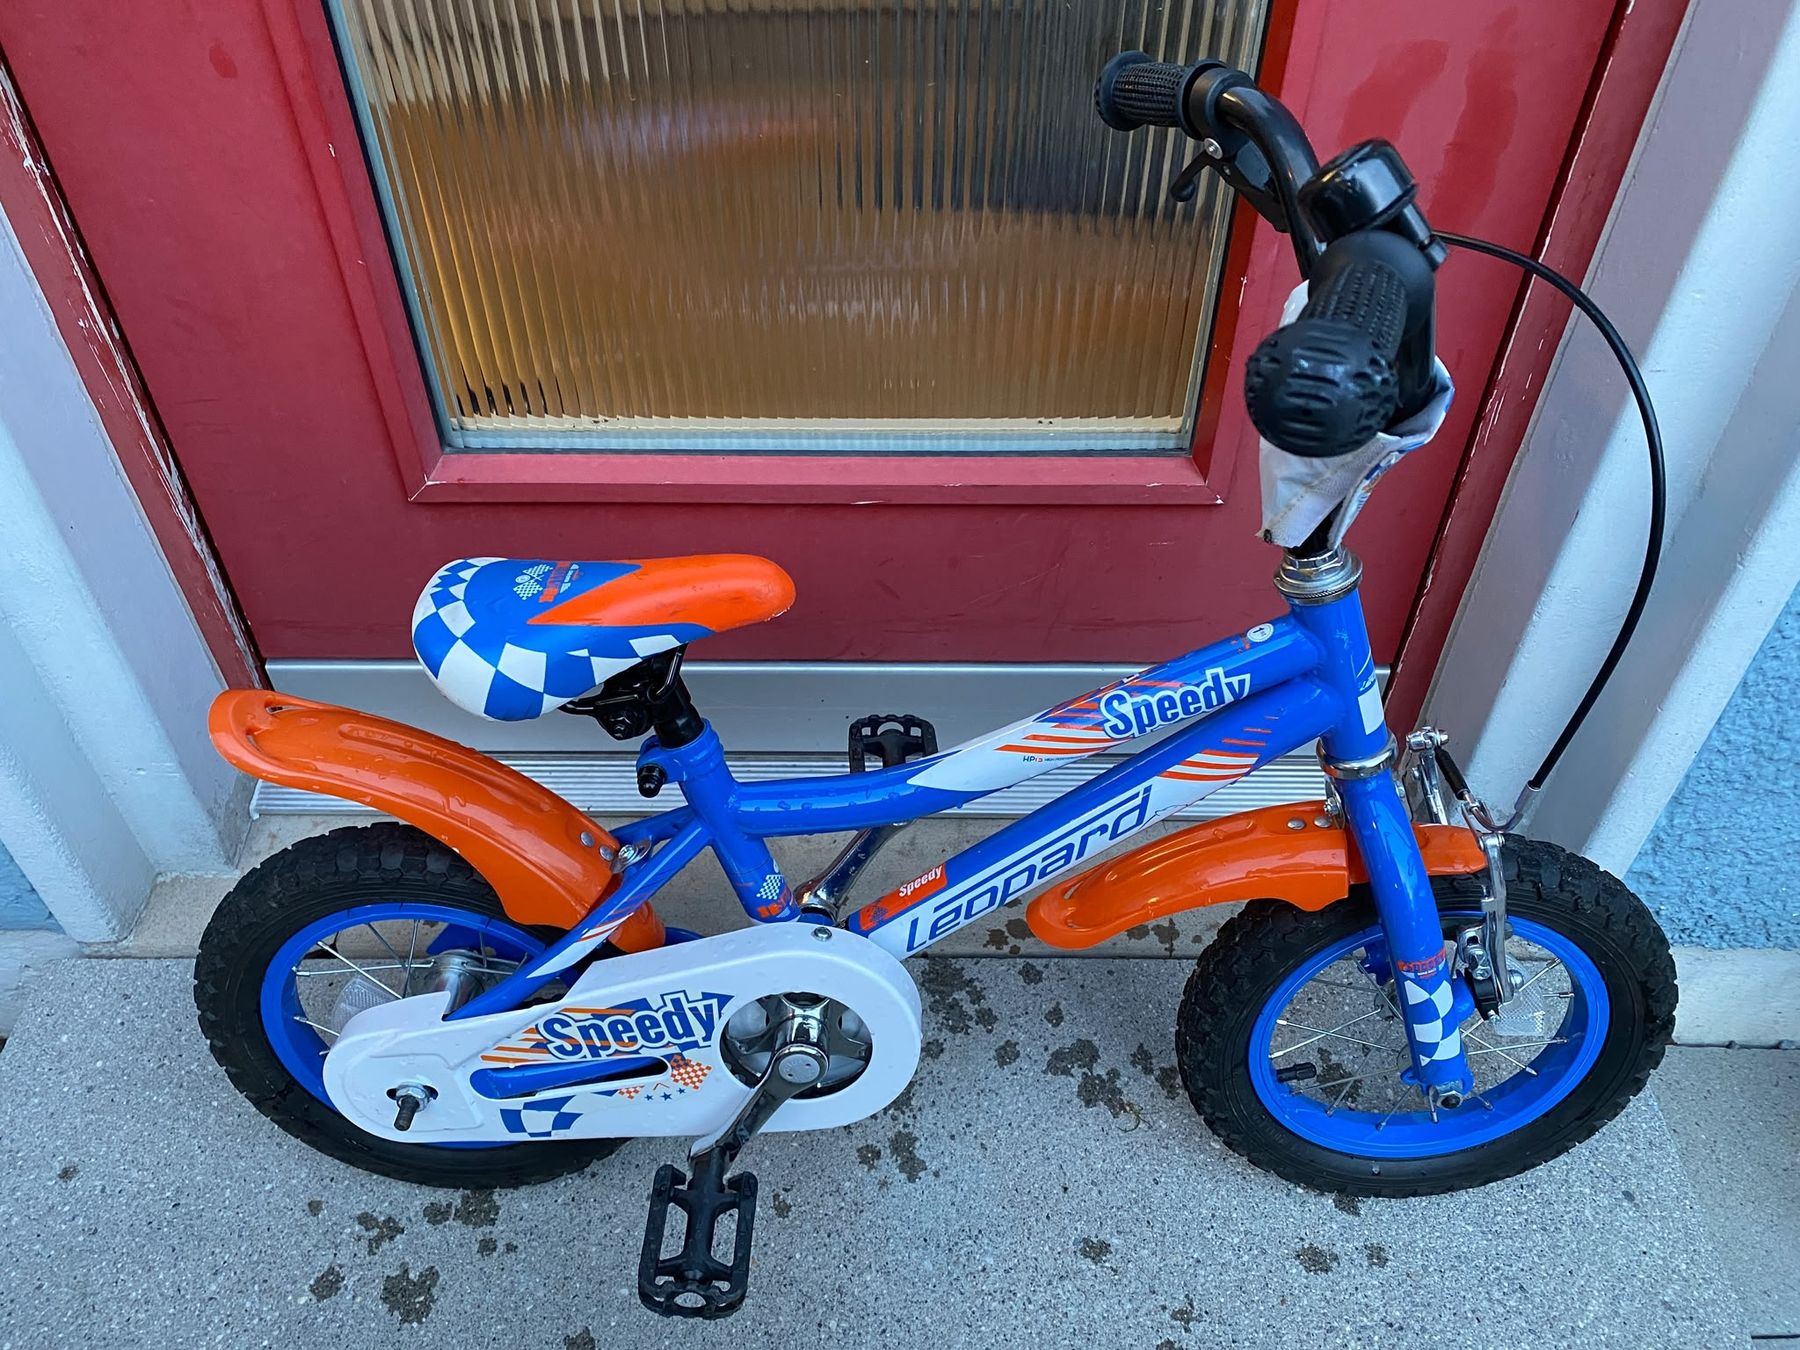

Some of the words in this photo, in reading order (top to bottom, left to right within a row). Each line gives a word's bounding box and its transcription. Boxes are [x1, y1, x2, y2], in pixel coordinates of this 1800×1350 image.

[1101, 667, 1251, 739] Speedy
[899, 865, 943, 897] Speedy
[906, 785, 1153, 953] Leopard
[540, 990, 720, 1059] Speedy
